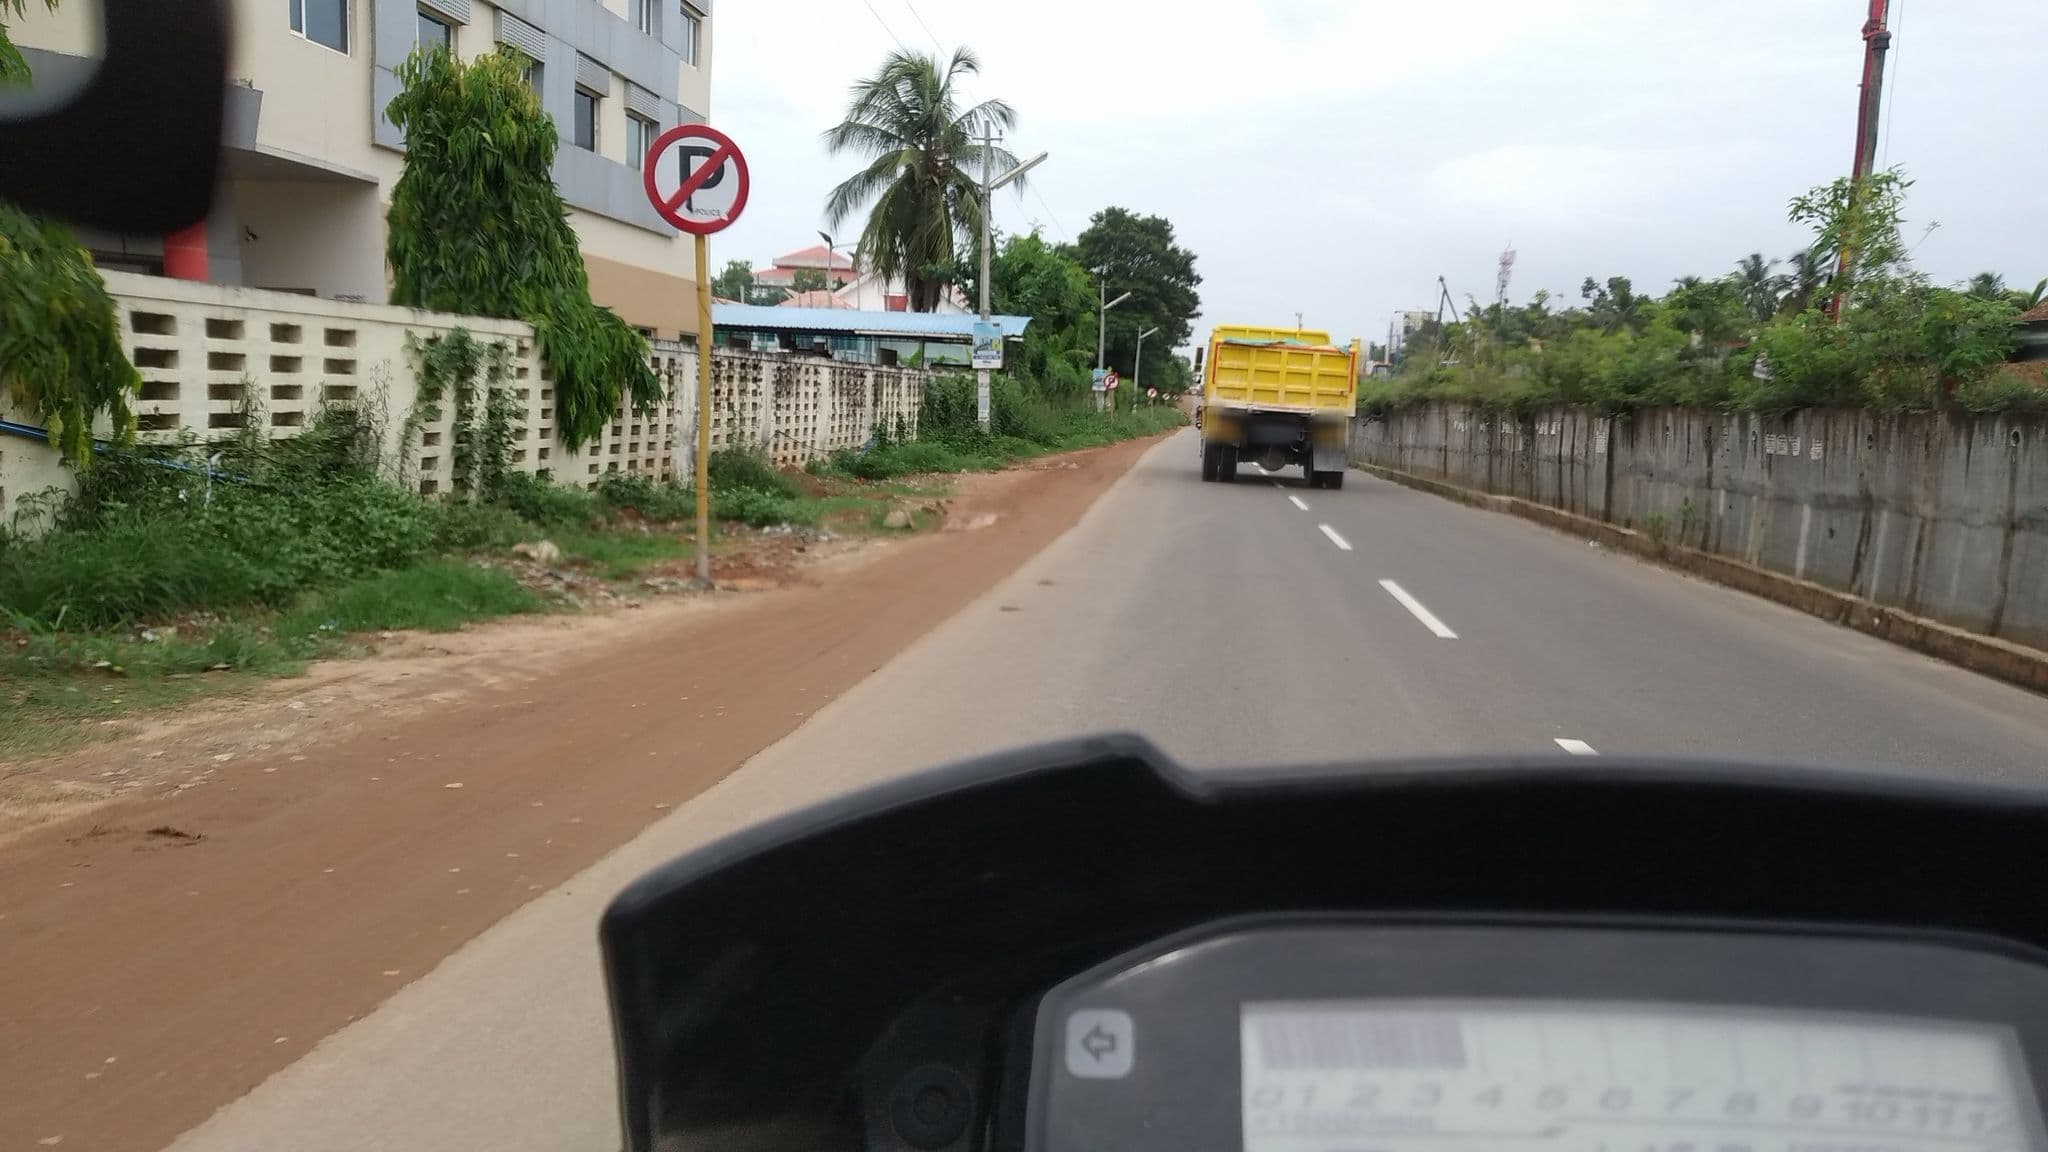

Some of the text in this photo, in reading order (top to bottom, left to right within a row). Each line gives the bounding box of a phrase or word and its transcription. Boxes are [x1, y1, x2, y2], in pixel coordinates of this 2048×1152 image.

[679, 146, 725, 213] P
[1251, 1084, 1283, 1109] 0
[1301, 1083, 1317, 1108] 1
[1347, 1082, 1381, 1111] 2
[1410, 1082, 1443, 1109] 3
[1472, 1083, 1504, 1109] 4
[1535, 1085, 1568, 1111] 5
[1597, 1085, 1633, 1111] 6
[1664, 1087, 1696, 1113] 7
[1722, 1091, 1759, 1118] 8
[1787, 1093, 1823, 1119] 9
[1844, 1099, 1900, 1125] 10
[1914, 1102, 1954, 1129] 11
